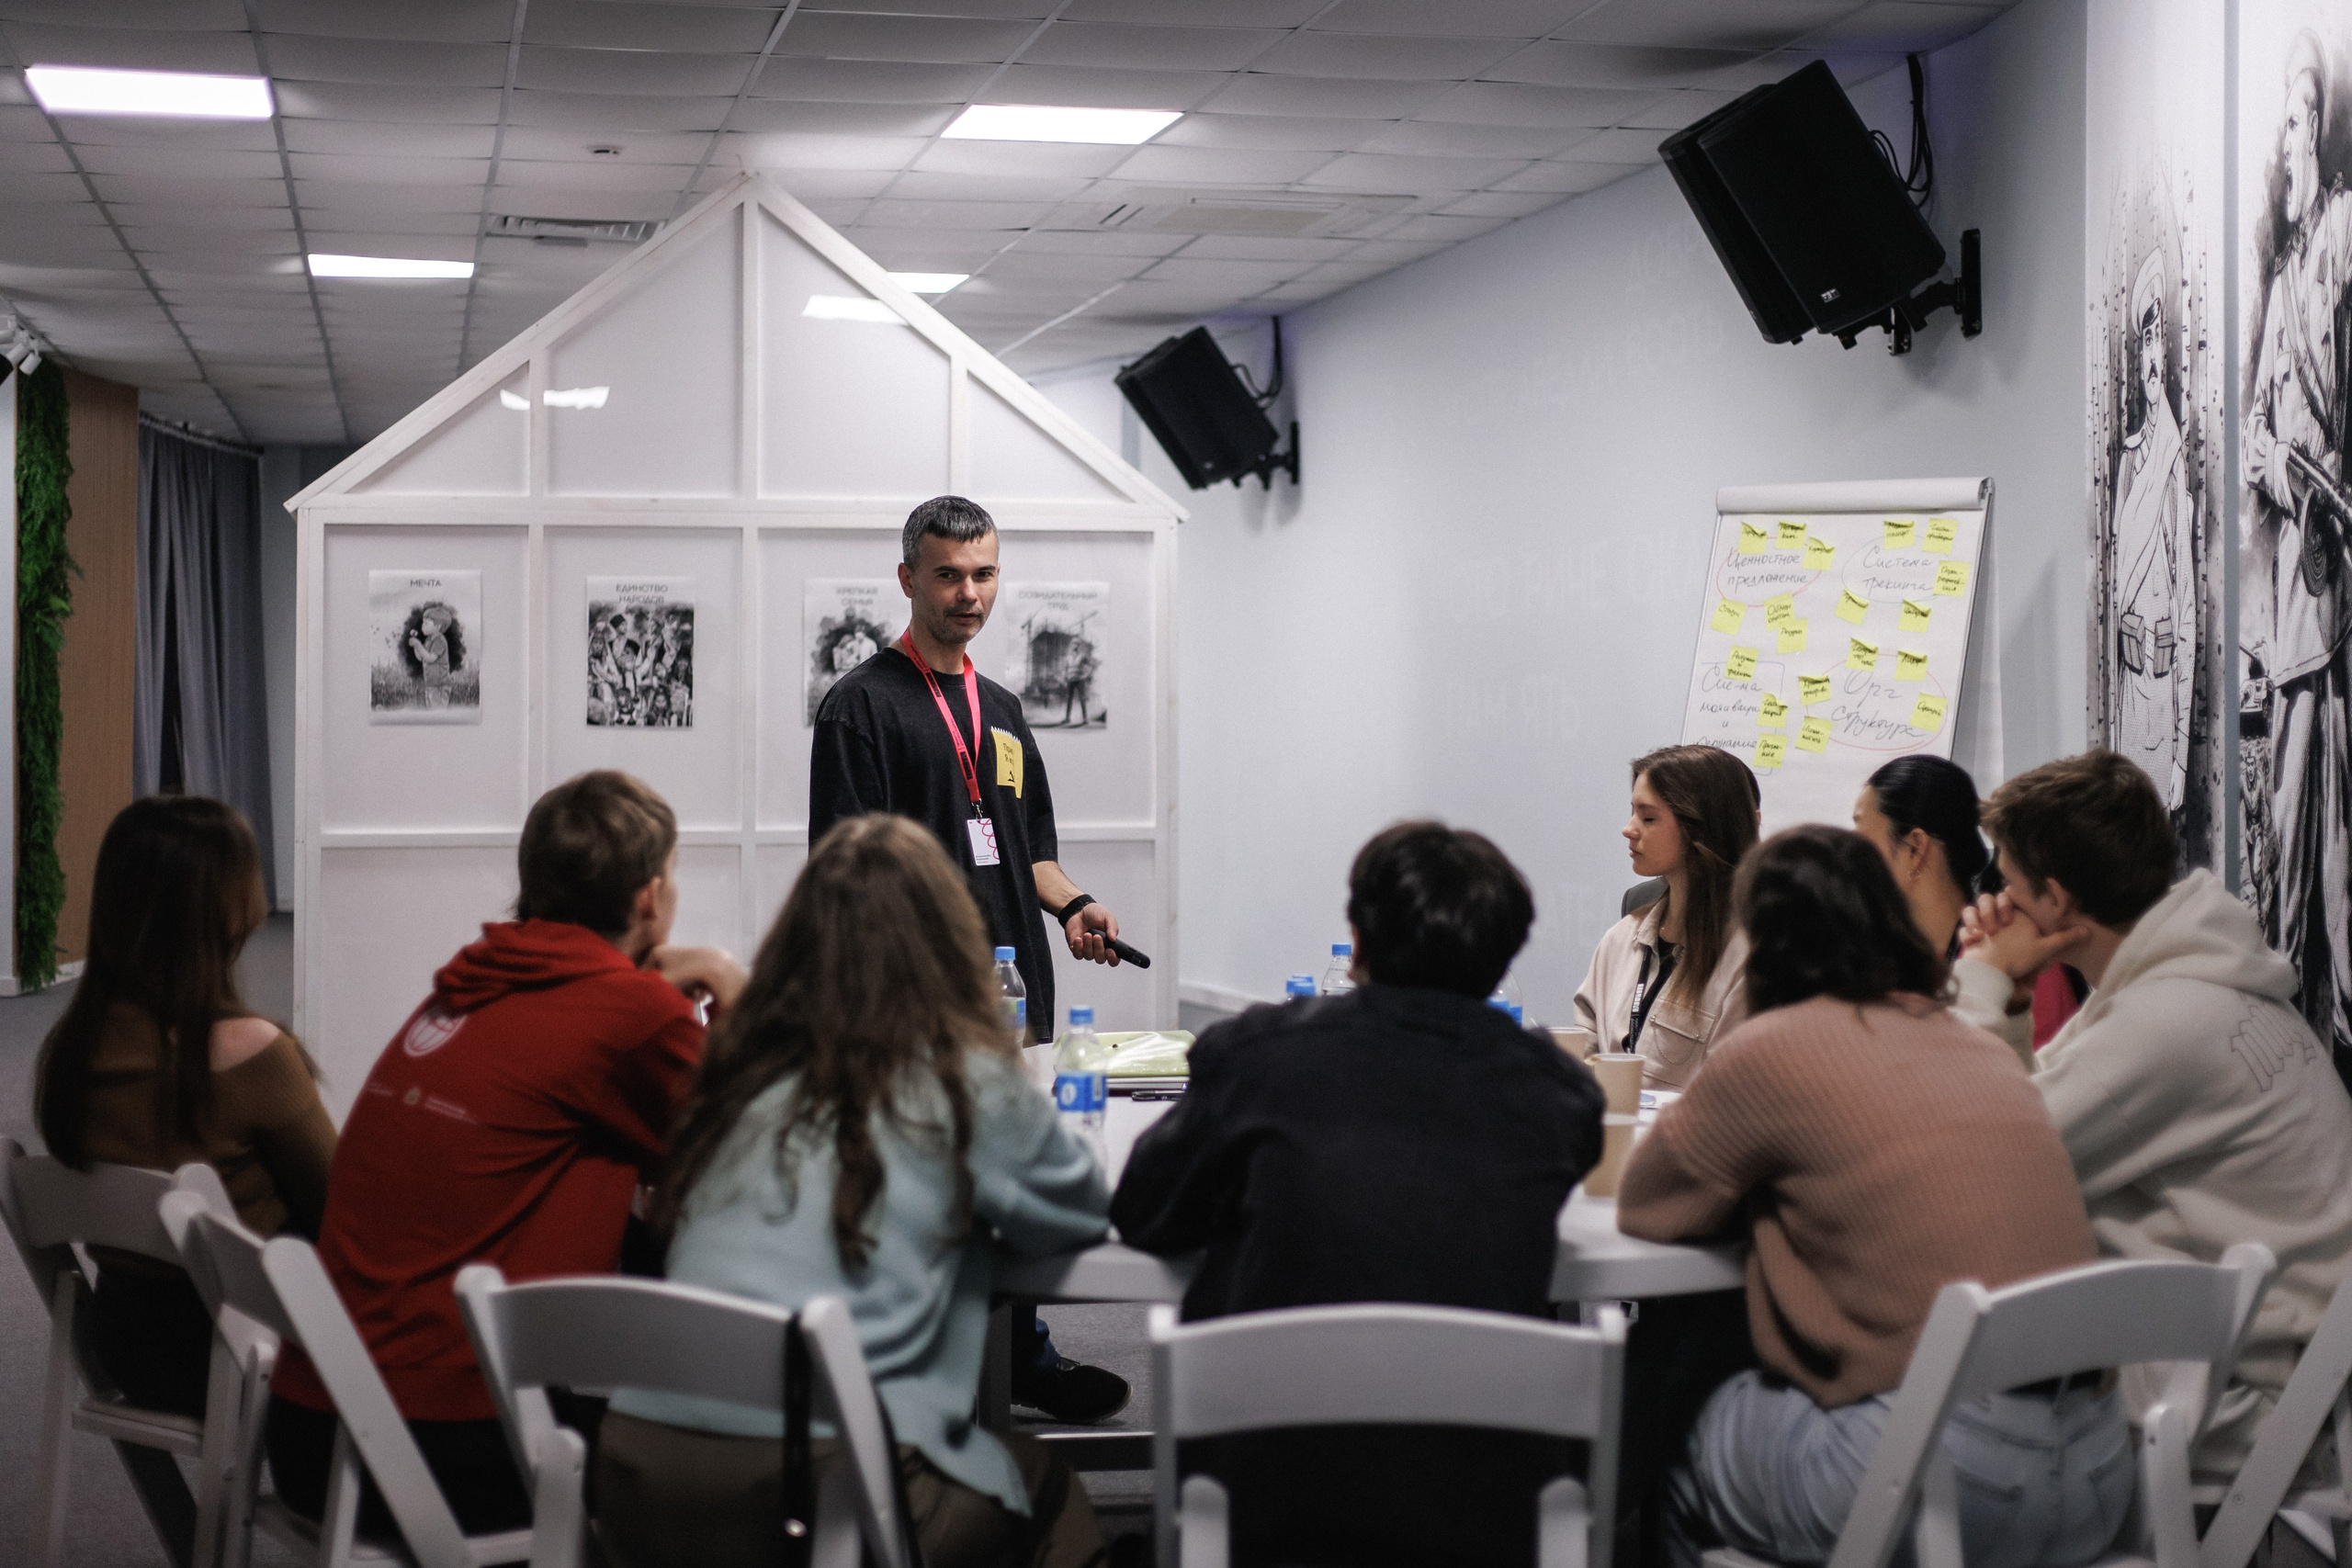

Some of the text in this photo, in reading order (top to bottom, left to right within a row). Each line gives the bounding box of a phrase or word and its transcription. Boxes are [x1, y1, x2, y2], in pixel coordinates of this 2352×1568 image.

[1727, 547, 1801, 570] Ценностное
[1862, 545, 1933, 569] Система
[410, 579, 441, 587] МЕЧТА
[616, 583, 669, 593] ЕДИНСТВО
[1727, 573, 1808, 593] предложение
[1862, 577, 1934, 597] трекинга
[619, 594, 665, 604] НАРОДОВ
